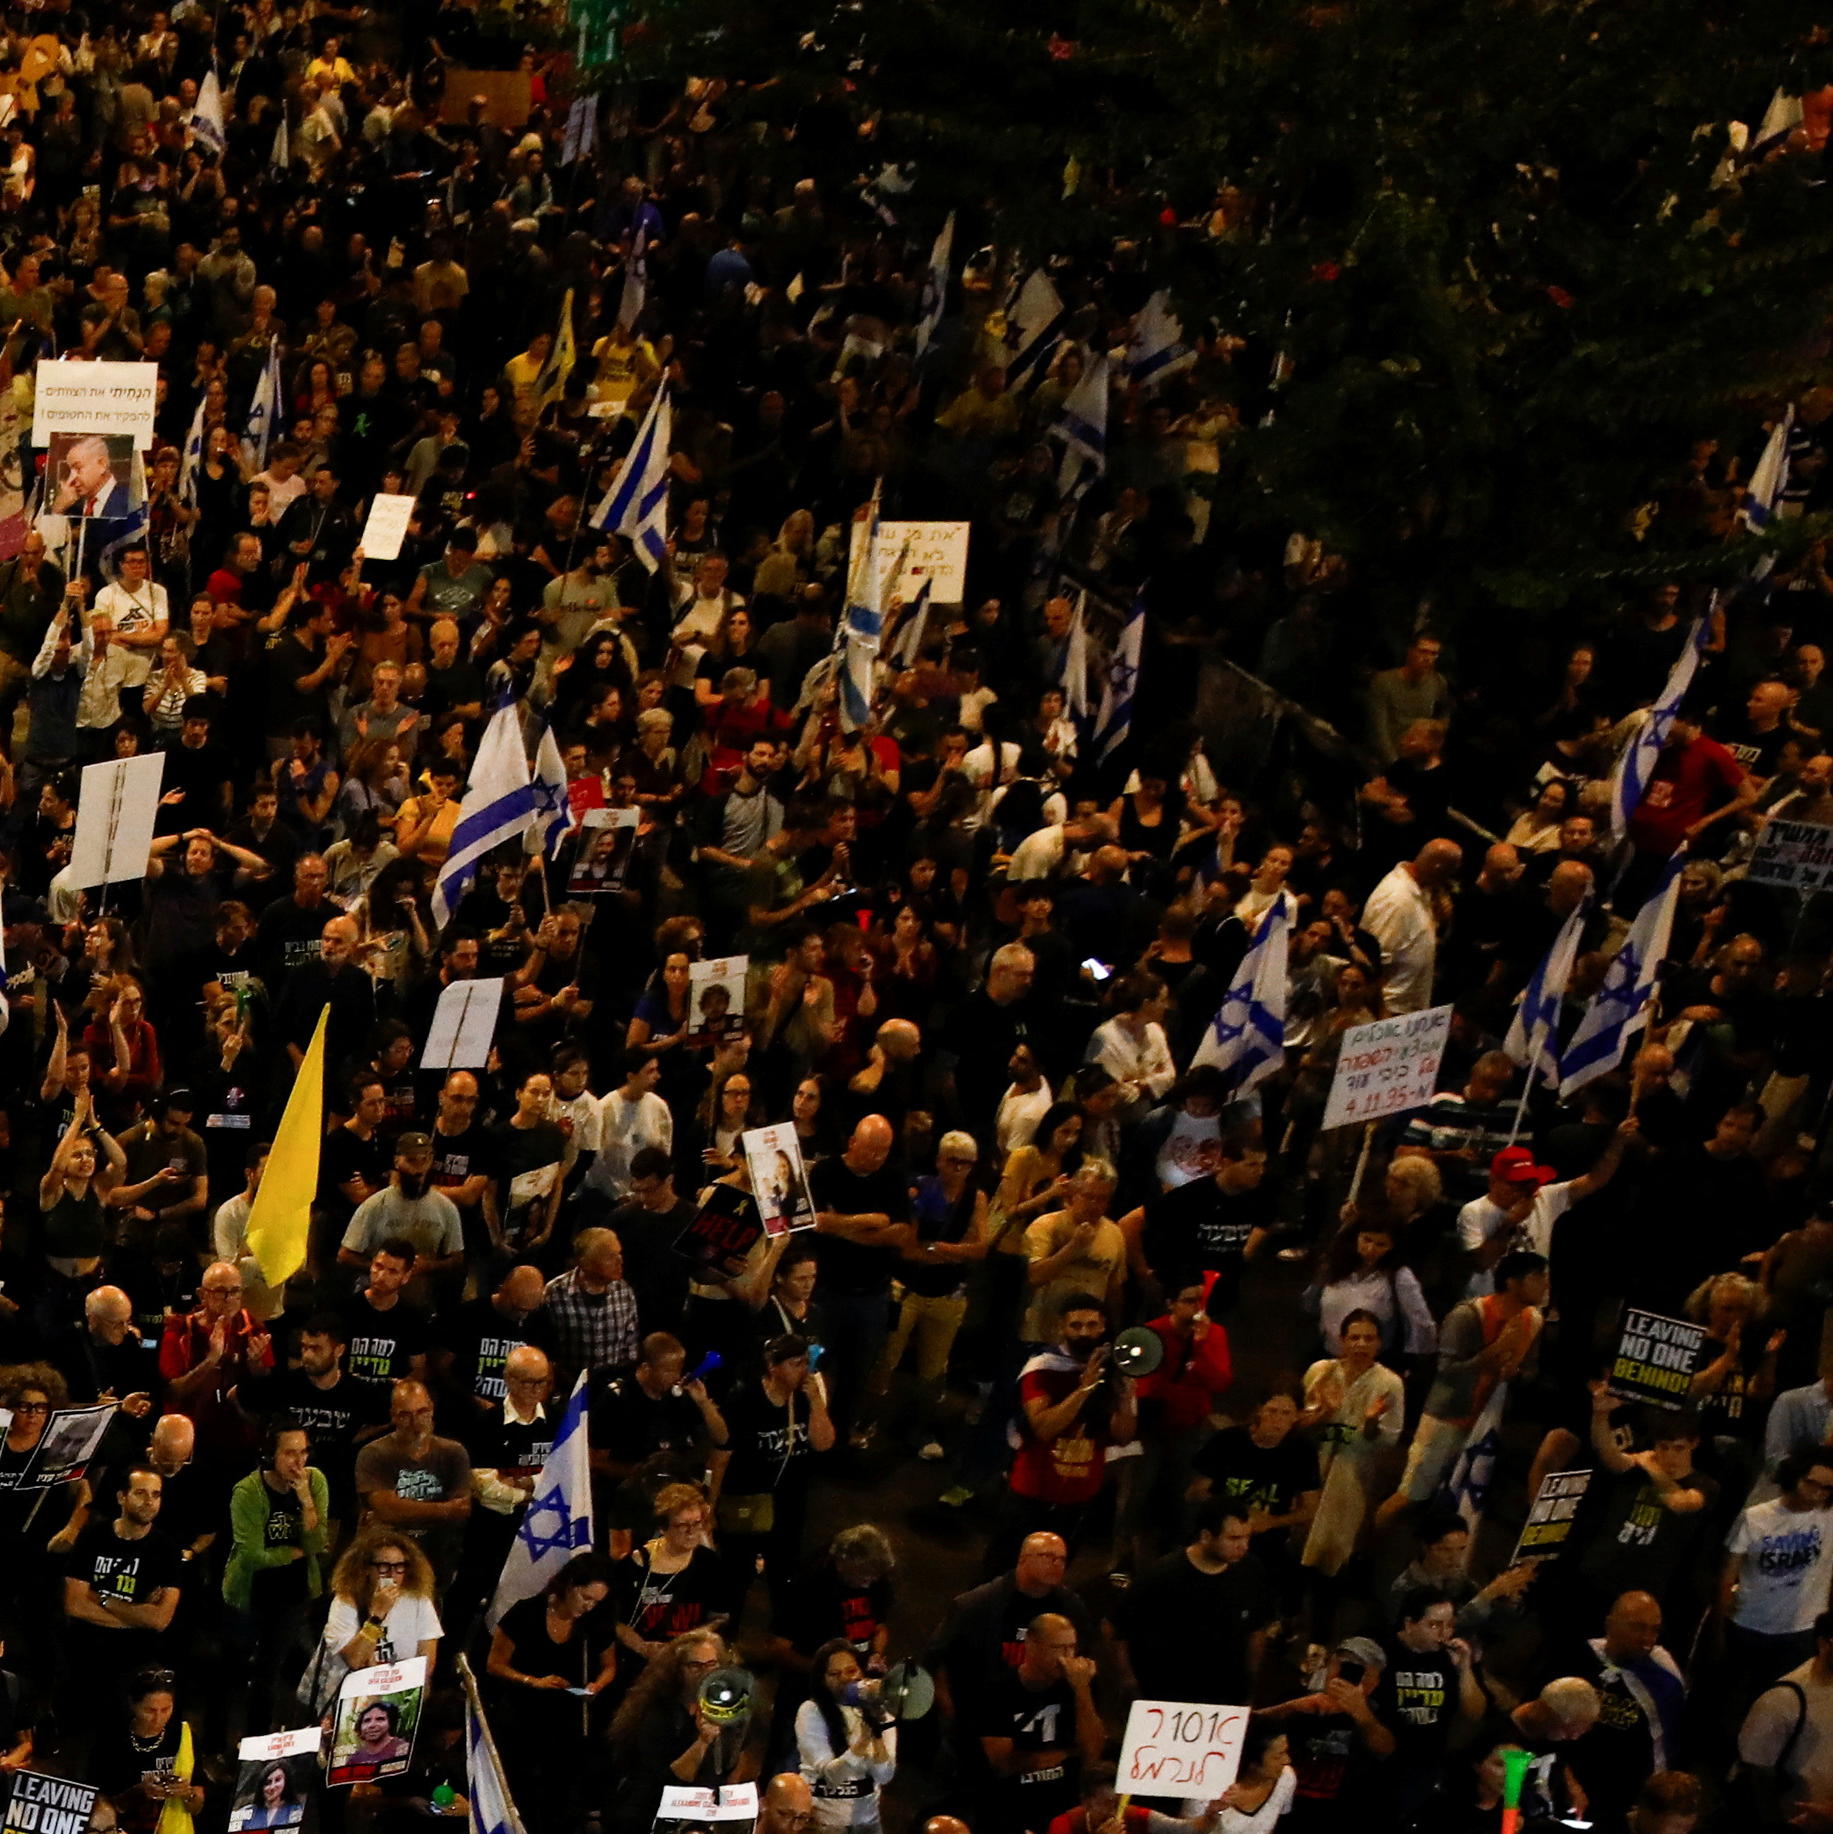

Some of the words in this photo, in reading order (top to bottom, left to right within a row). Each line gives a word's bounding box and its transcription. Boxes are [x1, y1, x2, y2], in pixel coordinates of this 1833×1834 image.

[1625, 1311, 1705, 1349] LEAVING
[1618, 1334, 1651, 1358] NO
[1651, 1342, 1698, 1373] ONE
[1613, 1356, 1692, 1395] BEHIND!
[12, 1774, 96, 1814] LEAVING
[4, 1799, 40, 1832] NO
